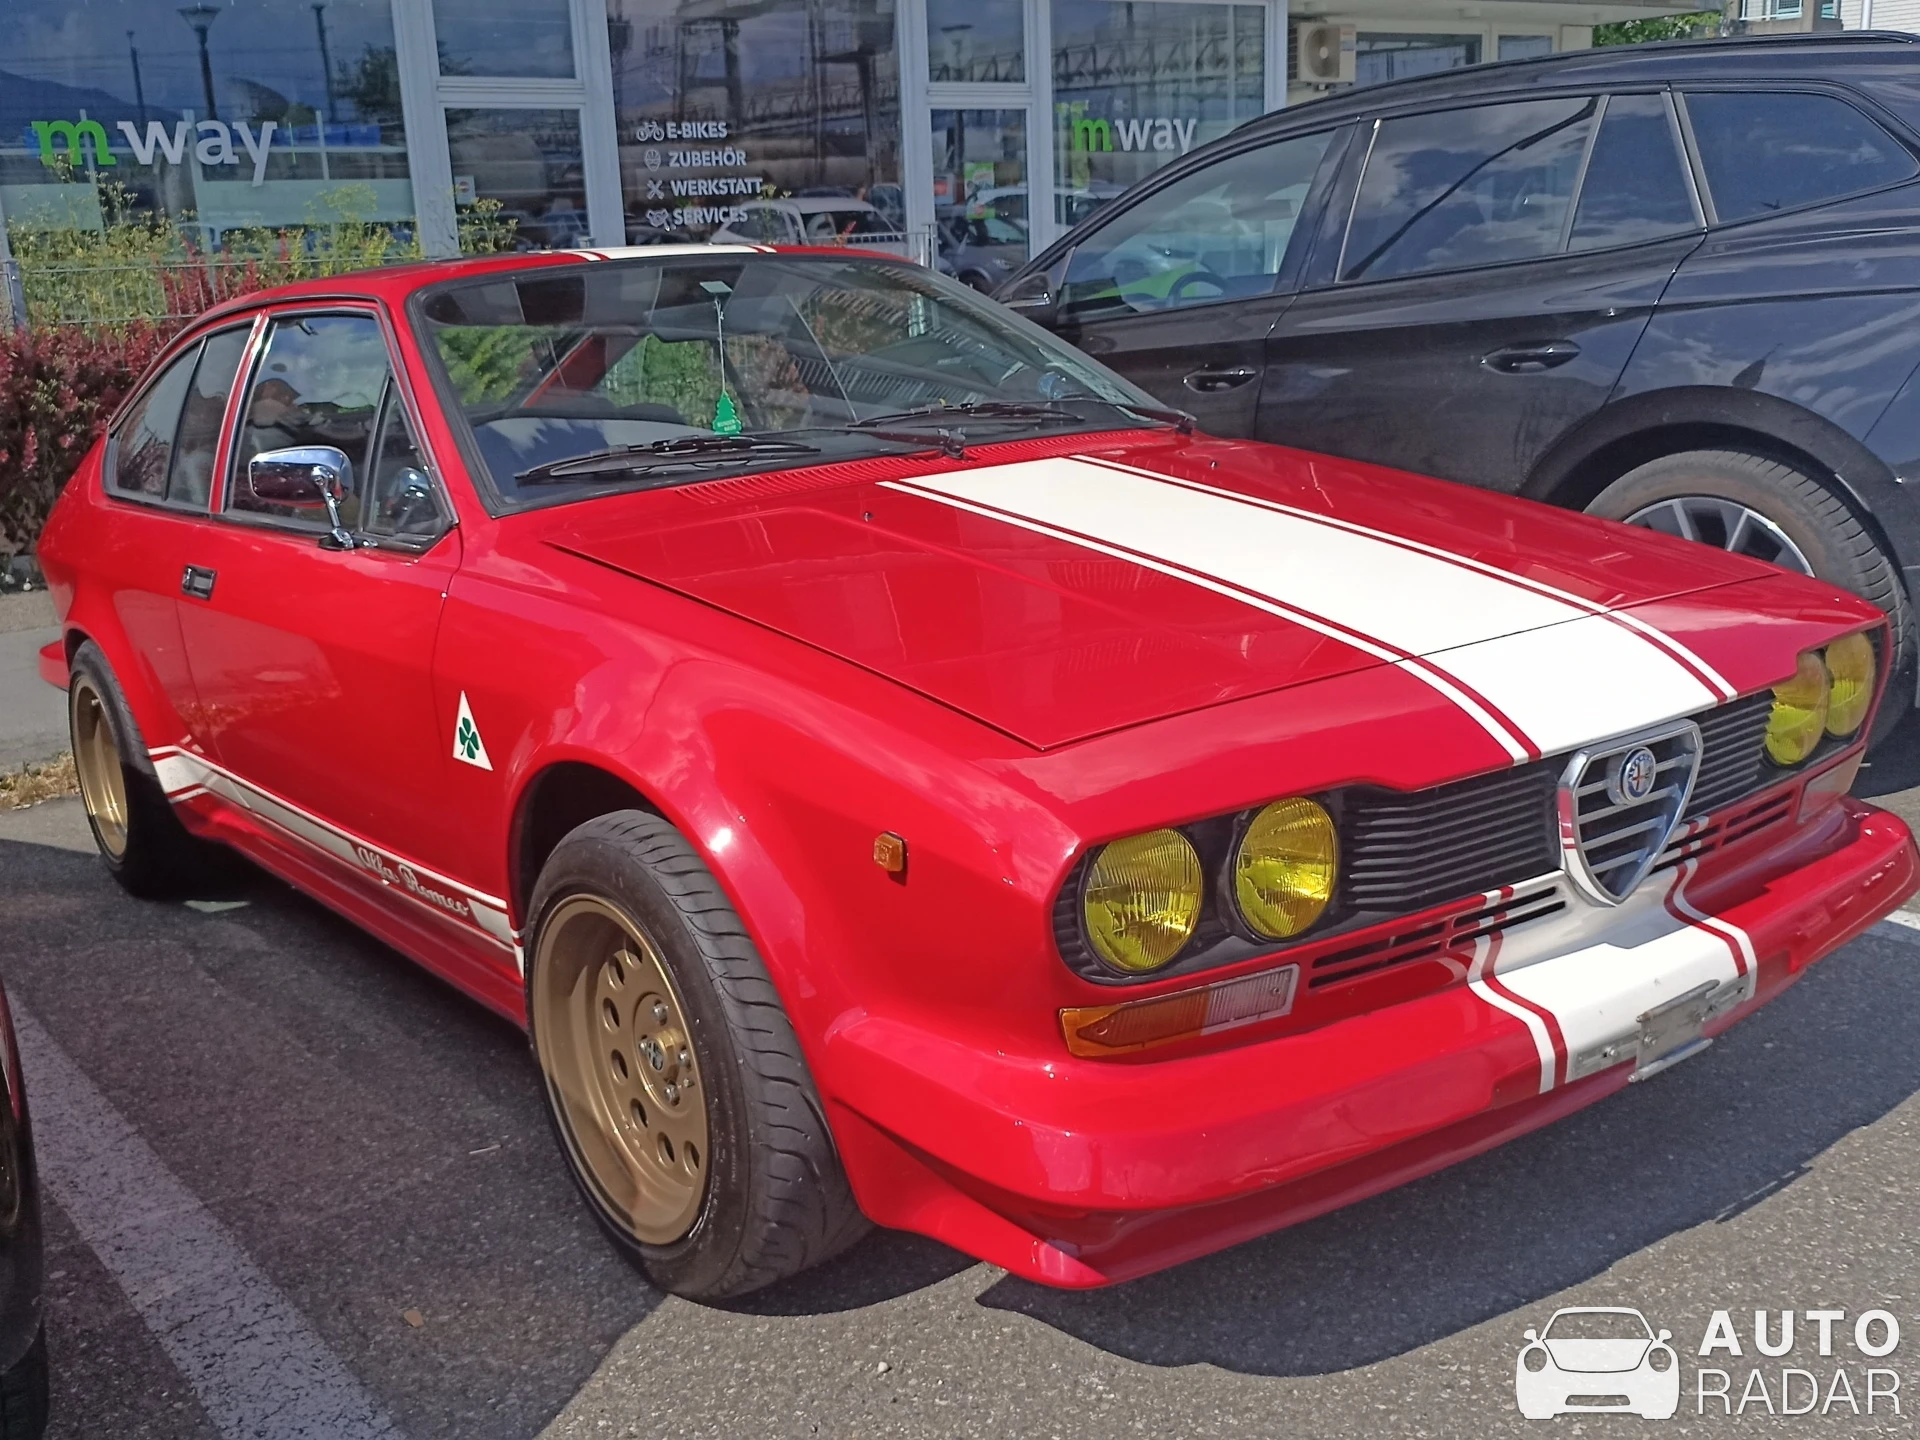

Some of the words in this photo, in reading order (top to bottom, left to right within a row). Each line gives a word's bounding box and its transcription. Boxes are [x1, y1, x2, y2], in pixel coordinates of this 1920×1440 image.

[666, 121, 728, 139] E-BIKES
[668, 146, 747, 168] ZUBEHÖR
[670, 176, 763, 197] WERKSTATT
[673, 206, 749, 225] SERVICES
